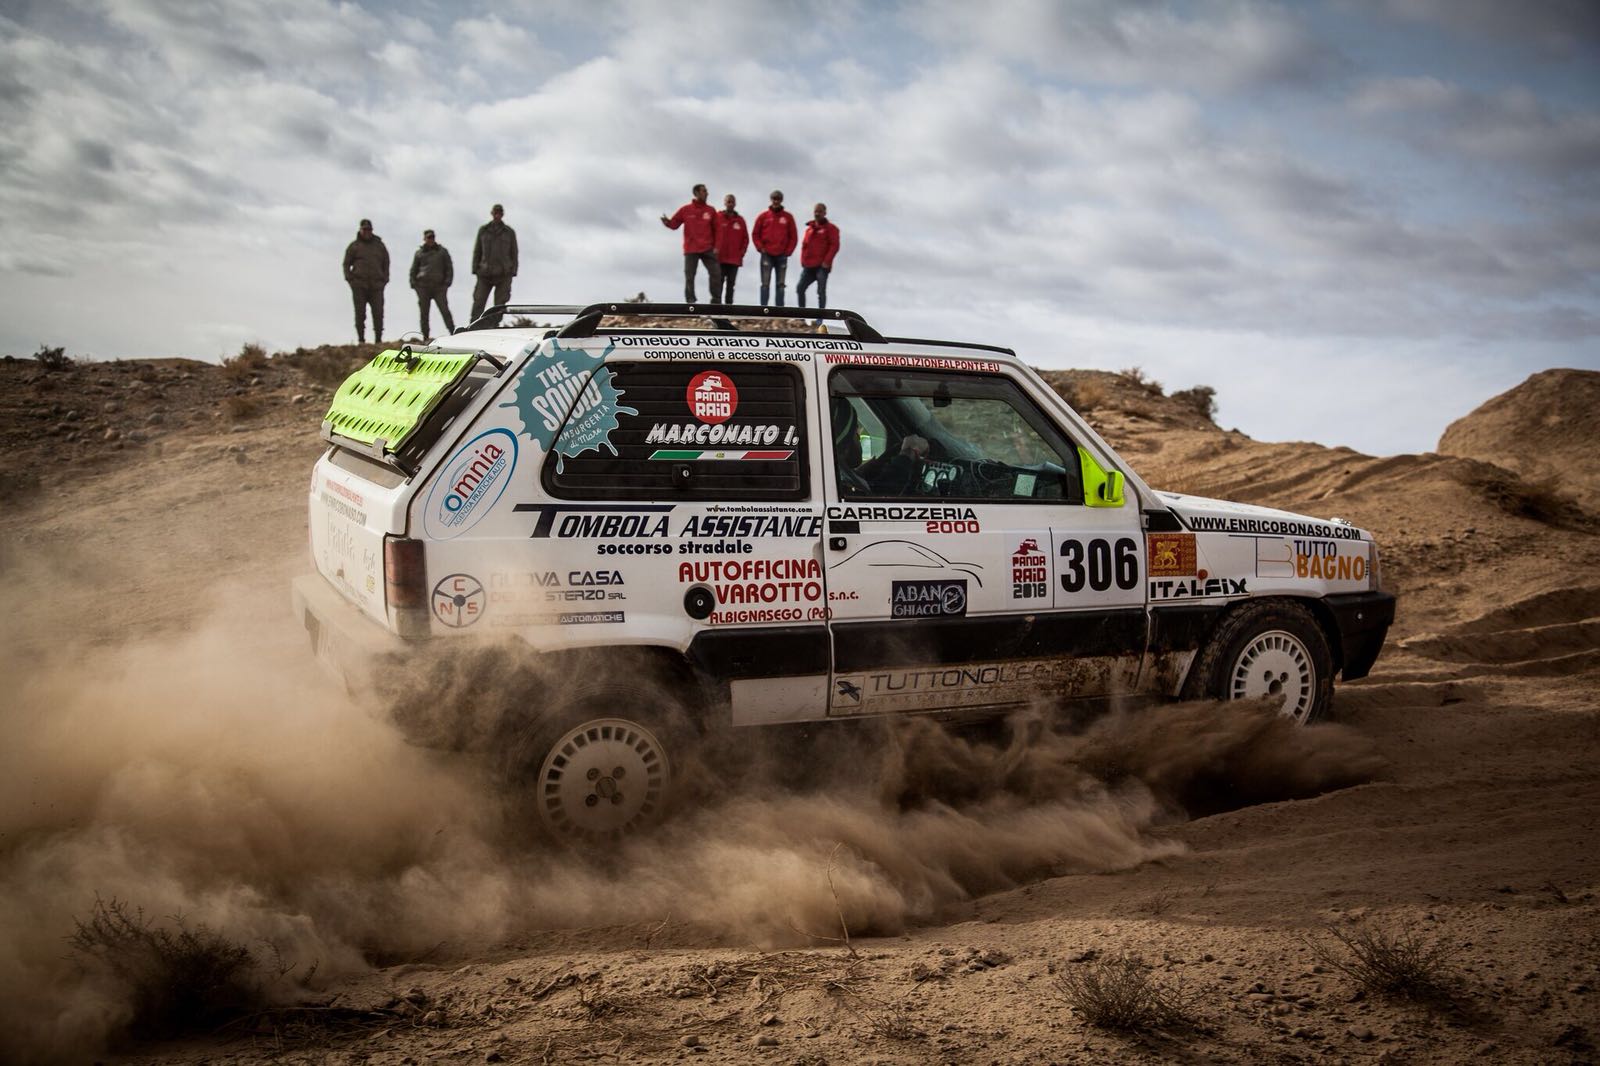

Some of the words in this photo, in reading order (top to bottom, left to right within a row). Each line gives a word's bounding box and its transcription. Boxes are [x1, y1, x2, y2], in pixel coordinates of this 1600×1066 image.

[609, 335, 690, 347] Pometto
[696, 336, 760, 348] Adriano
[765, 338, 863, 350] Autoricambi
[644, 350, 715, 361] componenti
[719, 352, 727, 360] e
[728, 351, 782, 361] accessori
[784, 352, 811, 362] auto
[825, 354, 1000, 372] WWW.AUTODEMOLIZIONEALPONTE.EU
[535, 361, 573, 388] THE
[531, 370, 603, 431] SQUID
[695, 392, 731, 402] PANDA
[645, 423, 780, 445] MARCONATO
[443, 443, 503, 512] omnia
[453, 500, 475, 528] AGENZIA
[471, 473, 494, 502] PRATICHE
[491, 458, 507, 478] AUTO
[706, 505, 813, 513] www.tombolaassistance.com
[827, 506, 978, 520] CARROZZERIA
[512, 503, 676, 538] TOMBOLA
[679, 515, 823, 538] ASSISTANCE
[926, 520, 980, 534] 2000
[1189, 516, 1361, 540] WWW.ENRICOBONASO.COM
[597, 543, 673, 555] soccorso
[678, 539, 753, 555] stradale
[1293, 540, 1338, 560] TUTTO
[679, 558, 821, 582] AUTOFFICINA
[1012, 556, 1046, 567] PANDA
[1059, 537, 1139, 593] 306
[1296, 554, 1365, 581] BAGNO
[568, 570, 625, 586] CASA
[545, 590, 606, 602] STERZO
[608, 592, 627, 600] SRL
[715, 582, 821, 604] VAROTTO
[829, 591, 859, 601] s.n.c.
[1013, 583, 1047, 599] 2018
[710, 608, 803, 624] ALBIGNASEGO
[893, 603, 941, 616] GHIACCI
